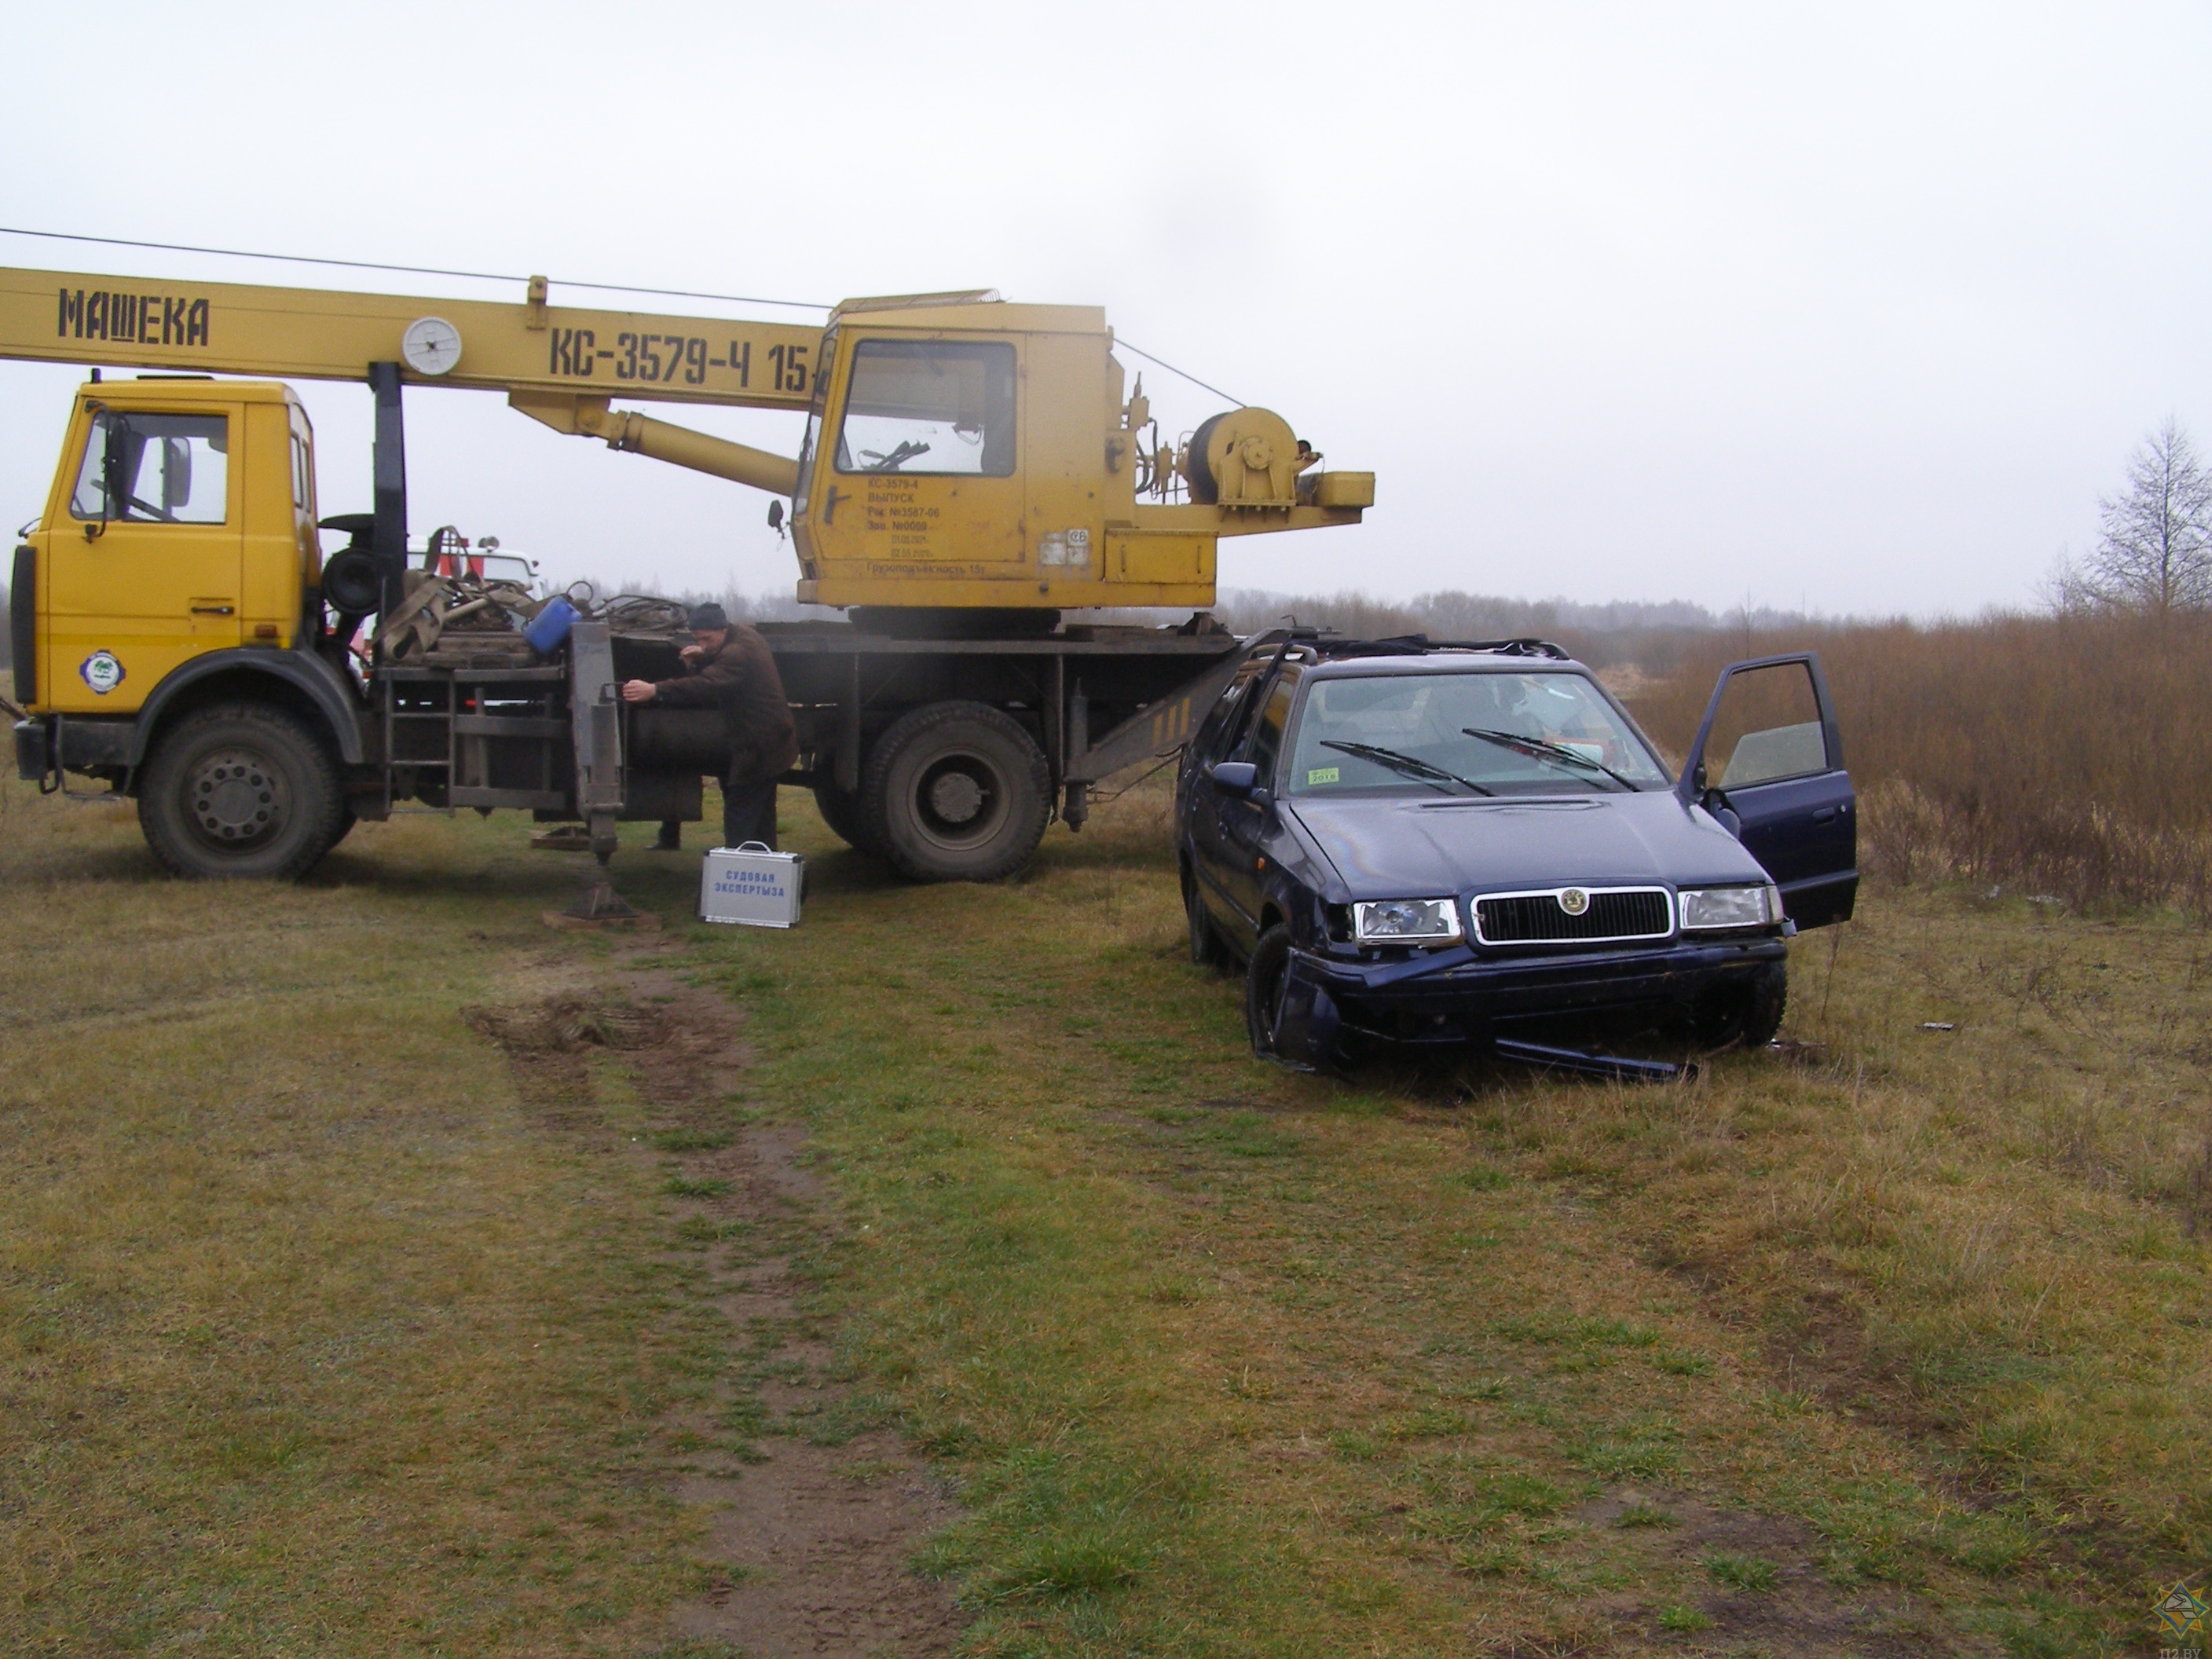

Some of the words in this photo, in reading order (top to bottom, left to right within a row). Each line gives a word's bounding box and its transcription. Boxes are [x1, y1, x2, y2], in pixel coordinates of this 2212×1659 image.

[59, 287, 210, 346] МАШЕКА
[550, 327, 751, 388] КС-3579-4
[868, 493, 914, 503] ВЫПУСК
[726, 870, 775, 882] СУДОВАЯ
[714, 882, 784, 896] ЭКСПЕРТЫЗА
